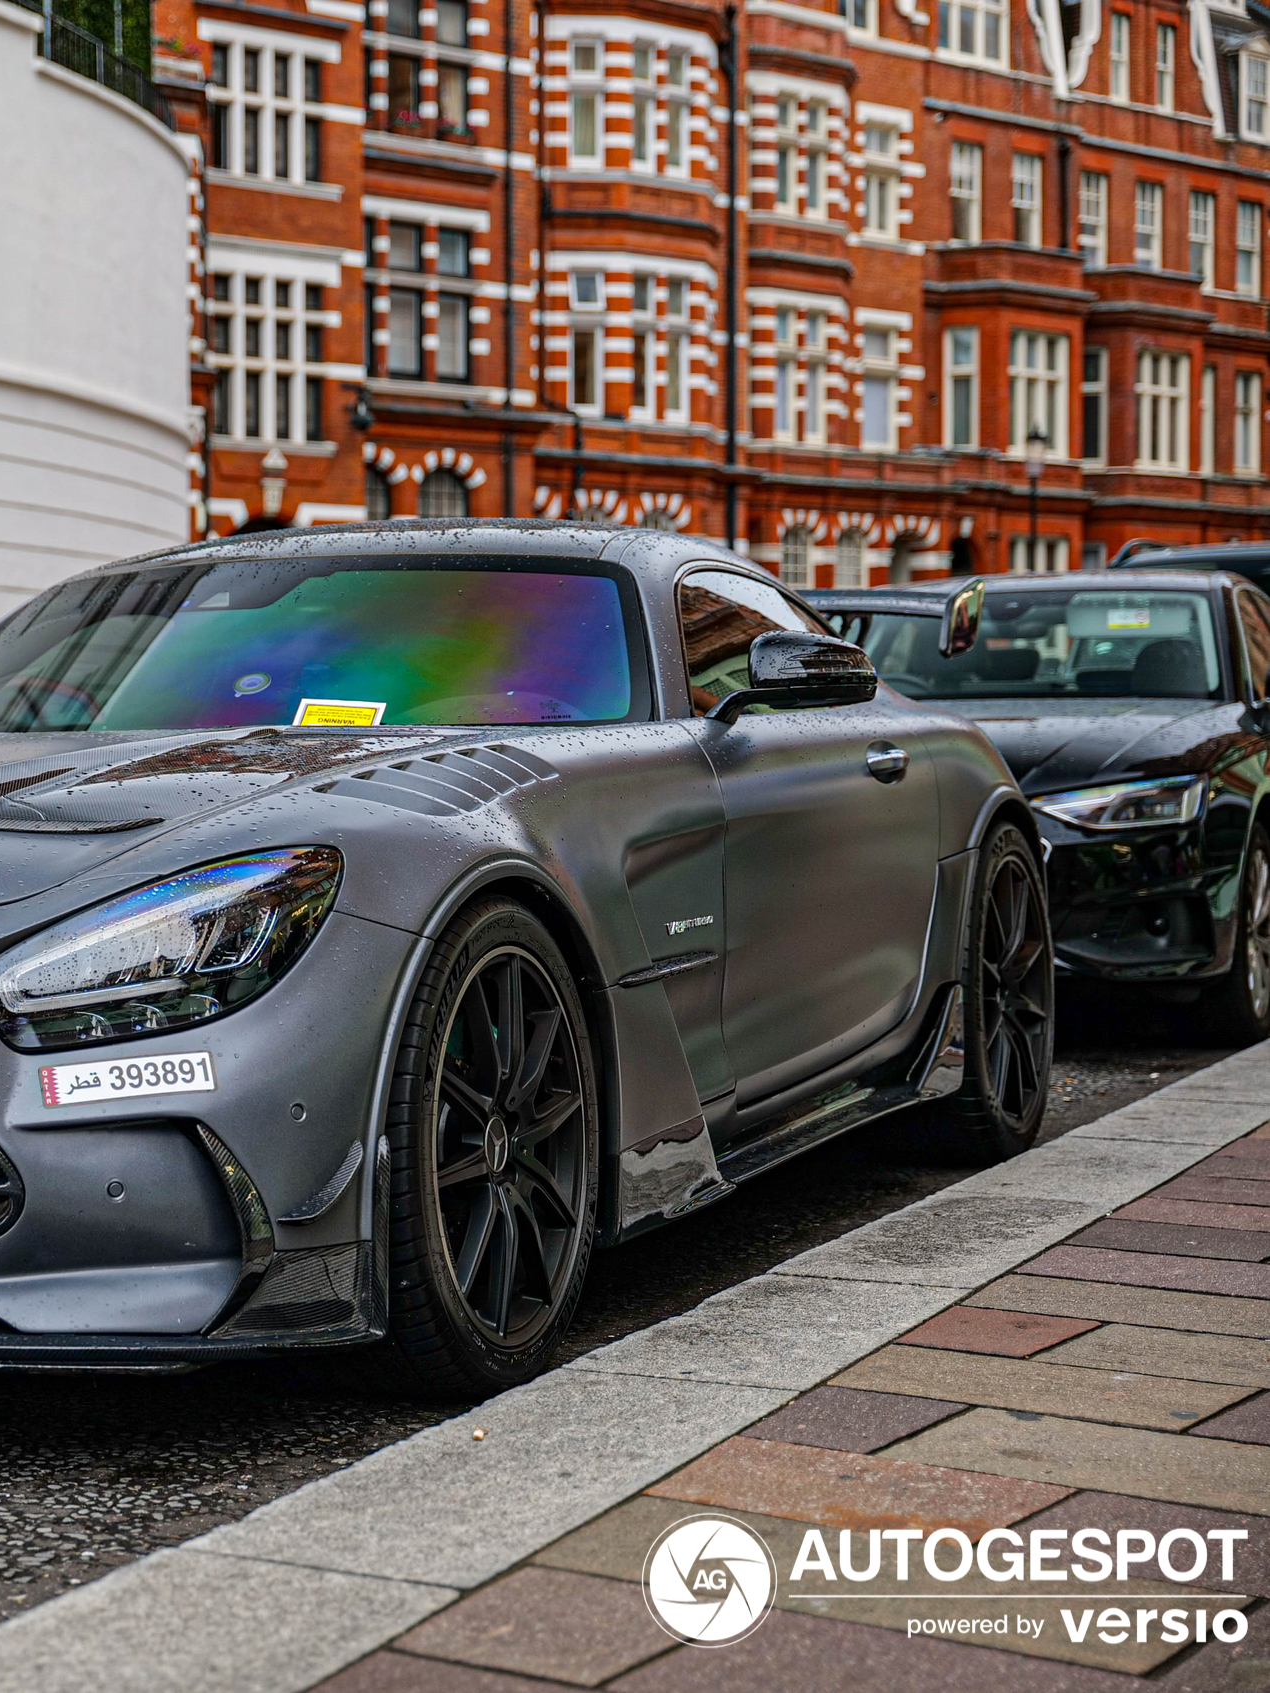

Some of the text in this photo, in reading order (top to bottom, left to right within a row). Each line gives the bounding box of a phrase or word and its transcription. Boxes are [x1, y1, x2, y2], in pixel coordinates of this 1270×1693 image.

[317, 717, 356, 725] WARNING
[429, 950, 469, 1070] MICHELIN
[42, 1070, 52, 1104] QATAR
[64, 1072, 101, 1095] قطر
[108, 1057, 210, 1091] 393891
